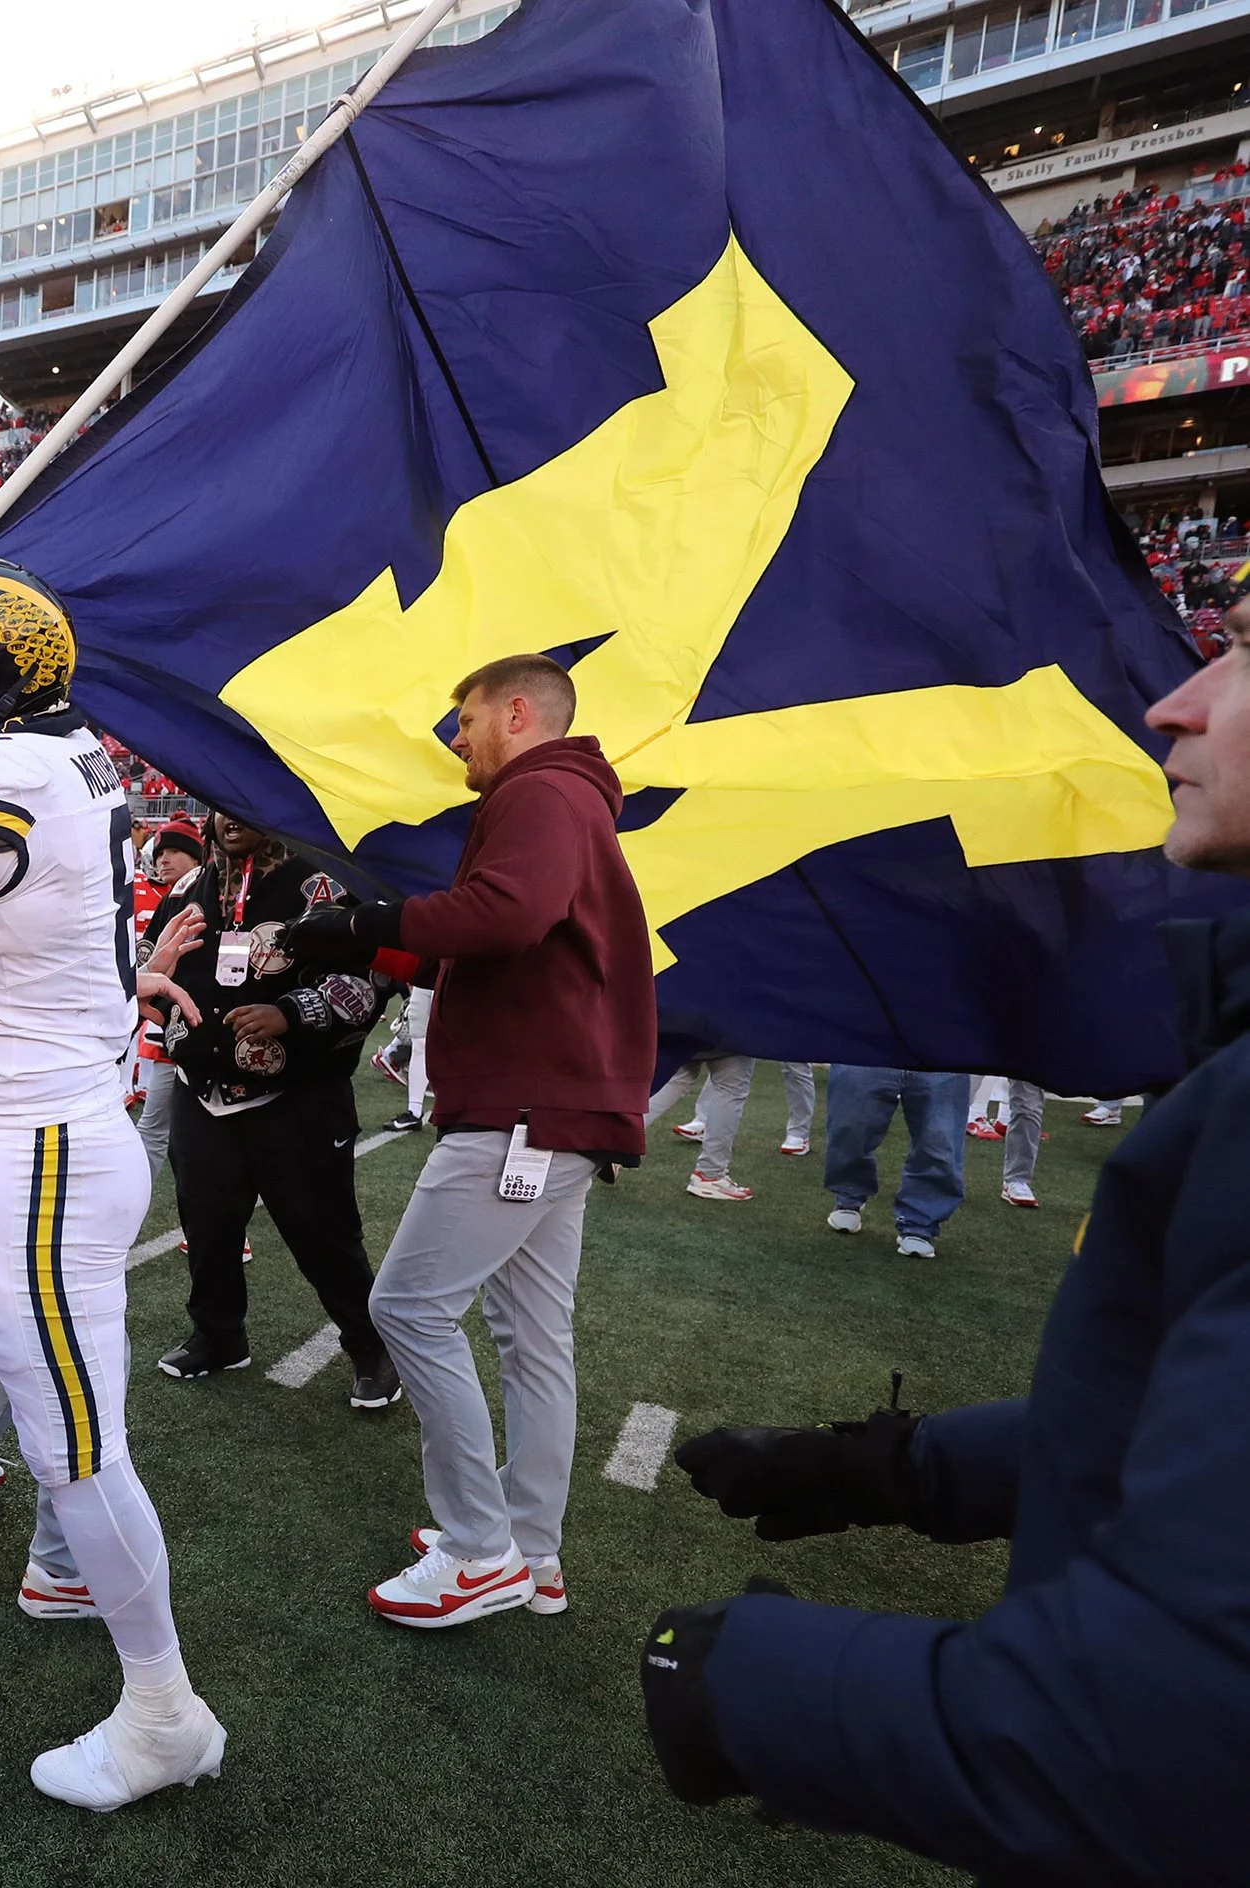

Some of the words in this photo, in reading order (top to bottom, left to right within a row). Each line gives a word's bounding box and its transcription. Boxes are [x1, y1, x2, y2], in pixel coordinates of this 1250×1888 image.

[1007, 161, 1054, 181] Shelly
[1064, 144, 1120, 167] Family
[1130, 124, 1205, 150] Pressbox
